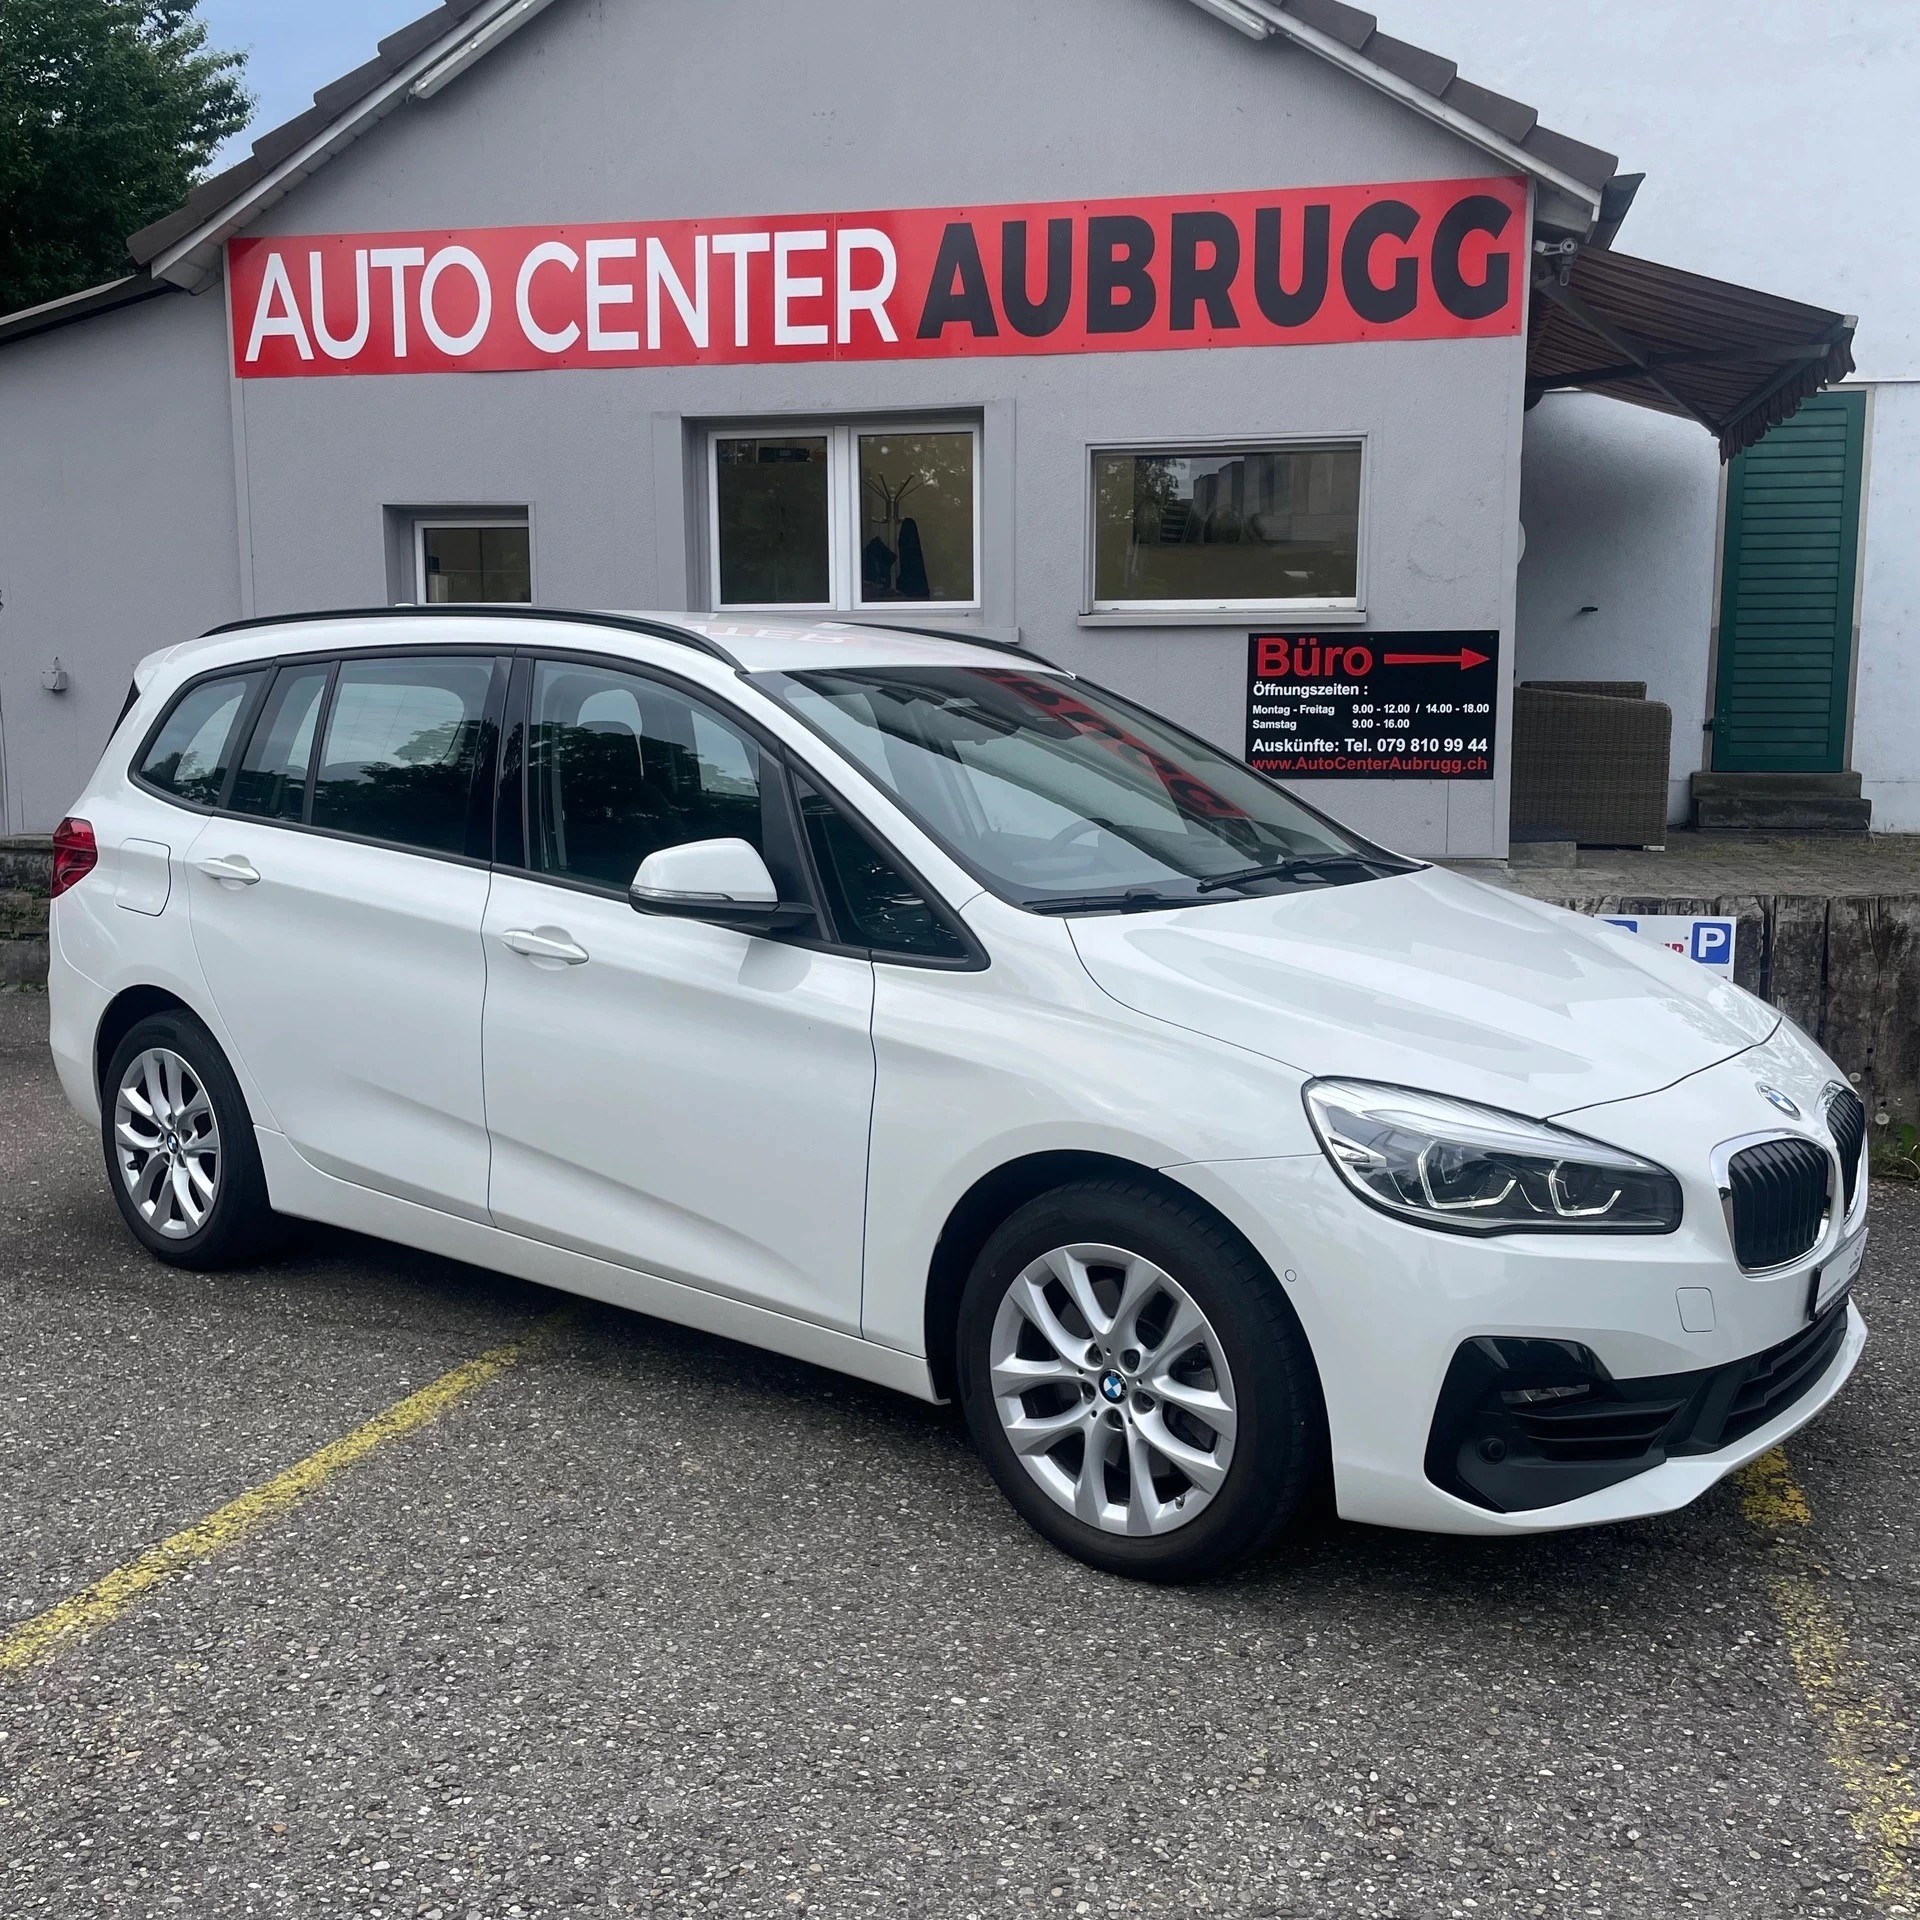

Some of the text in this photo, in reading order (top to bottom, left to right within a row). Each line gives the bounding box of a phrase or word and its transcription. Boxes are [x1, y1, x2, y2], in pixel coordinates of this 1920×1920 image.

[245, 195, 1513, 362] AUTO CENTER AUBRUGG
[1257, 637, 1373, 677] Büro
[1253, 681, 1359, 698] Öffnungszeiten
[1252, 704, 1291, 716] Montag
[1300, 704, 1335, 716] Freitag
[1352, 703, 1374, 714] 9.00
[1383, 703, 1411, 714] 12.00
[1425, 703, 1453, 714] 14.00
[1462, 703, 1490, 714] 18.00
[1252, 719, 1297, 731] Samstag
[1352, 718, 1374, 729] 9.00
[1383, 718, 1410, 729] 16.00
[1252, 738, 1488, 752] Auskünfte: Tel. 079 810 99 44
[1252, 756, 1488, 774] www.AutoCenterAubrugg.ch
[1697, 927, 1726, 958] P
